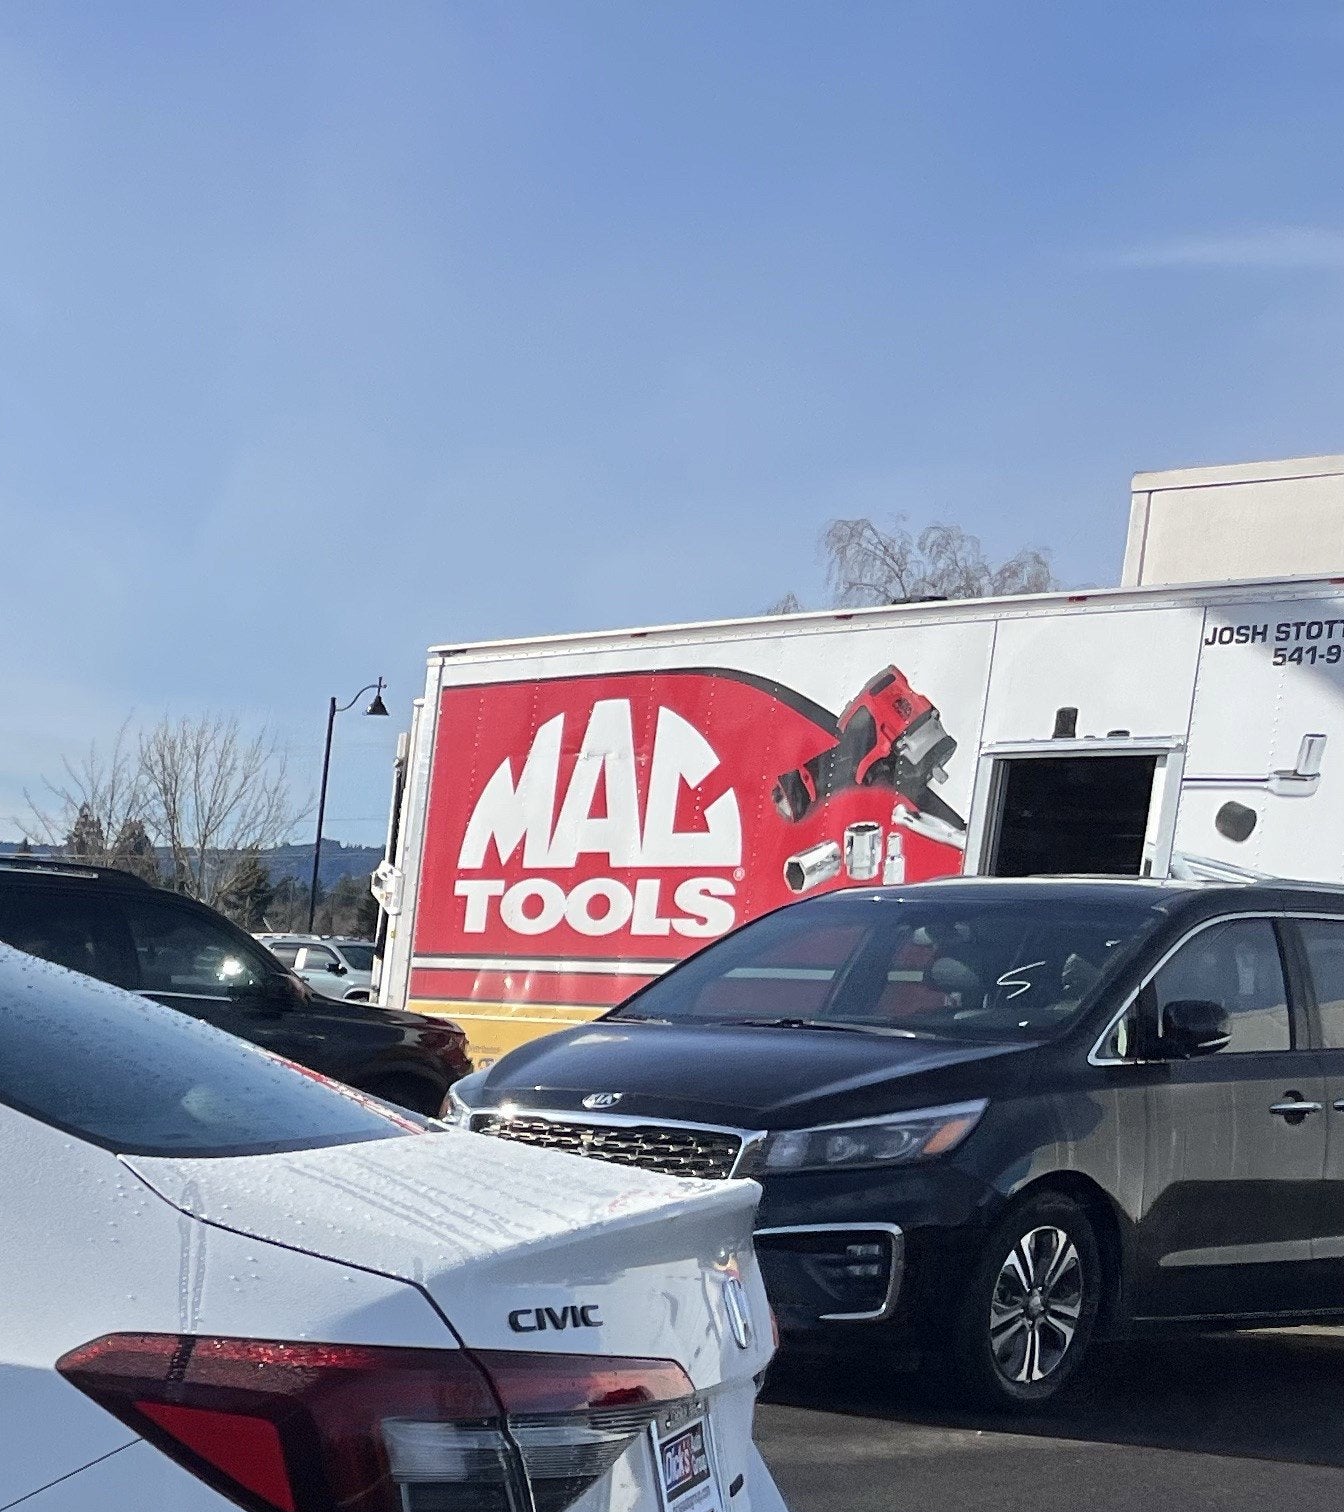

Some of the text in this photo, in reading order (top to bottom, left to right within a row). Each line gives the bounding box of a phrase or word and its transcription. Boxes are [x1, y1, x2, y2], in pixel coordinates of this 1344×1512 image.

[1204, 624, 1269, 646] JOSH
[1272, 645, 1344, 666] 541-9
[457, 698, 743, 869] MAC
[454, 876, 737, 938] TOOLS
[508, 1304, 604, 1333] CIVIC
